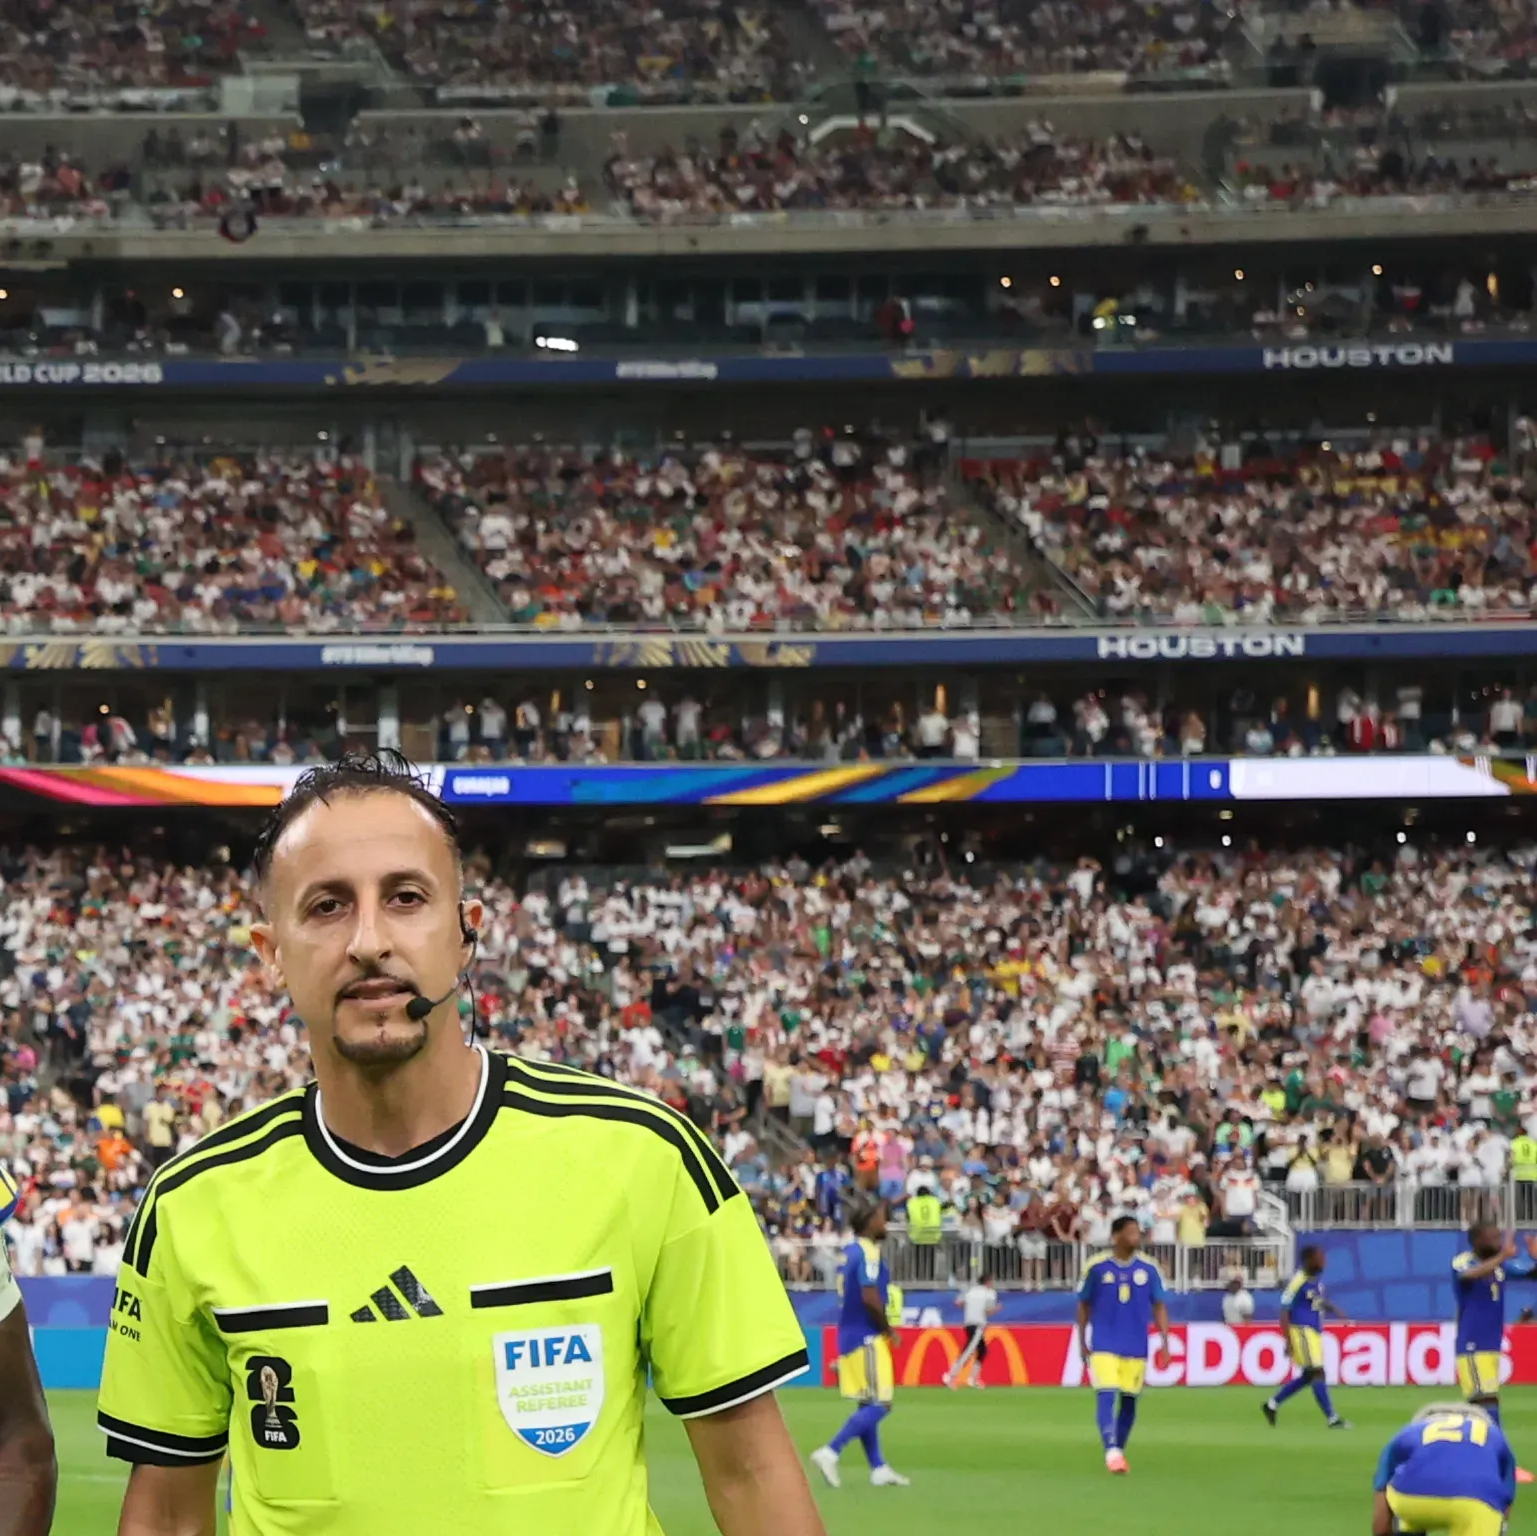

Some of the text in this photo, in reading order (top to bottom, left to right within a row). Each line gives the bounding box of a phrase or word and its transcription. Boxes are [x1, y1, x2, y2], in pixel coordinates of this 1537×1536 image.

[1262, 342, 1454, 369] HOUSTON
[34, 363, 80, 384] CUP
[83, 363, 163, 384] 2026
[1097, 635, 1305, 659] HOUSTON
[504, 1334, 593, 1371] FIFA
[508, 1378, 594, 1399] ASSISTANT
[516, 1394, 588, 1413] REFEREE
[264, 1430, 288, 1443] FIFA
[535, 1427, 576, 1445] 2026
[1422, 1412, 1489, 1447] 21
